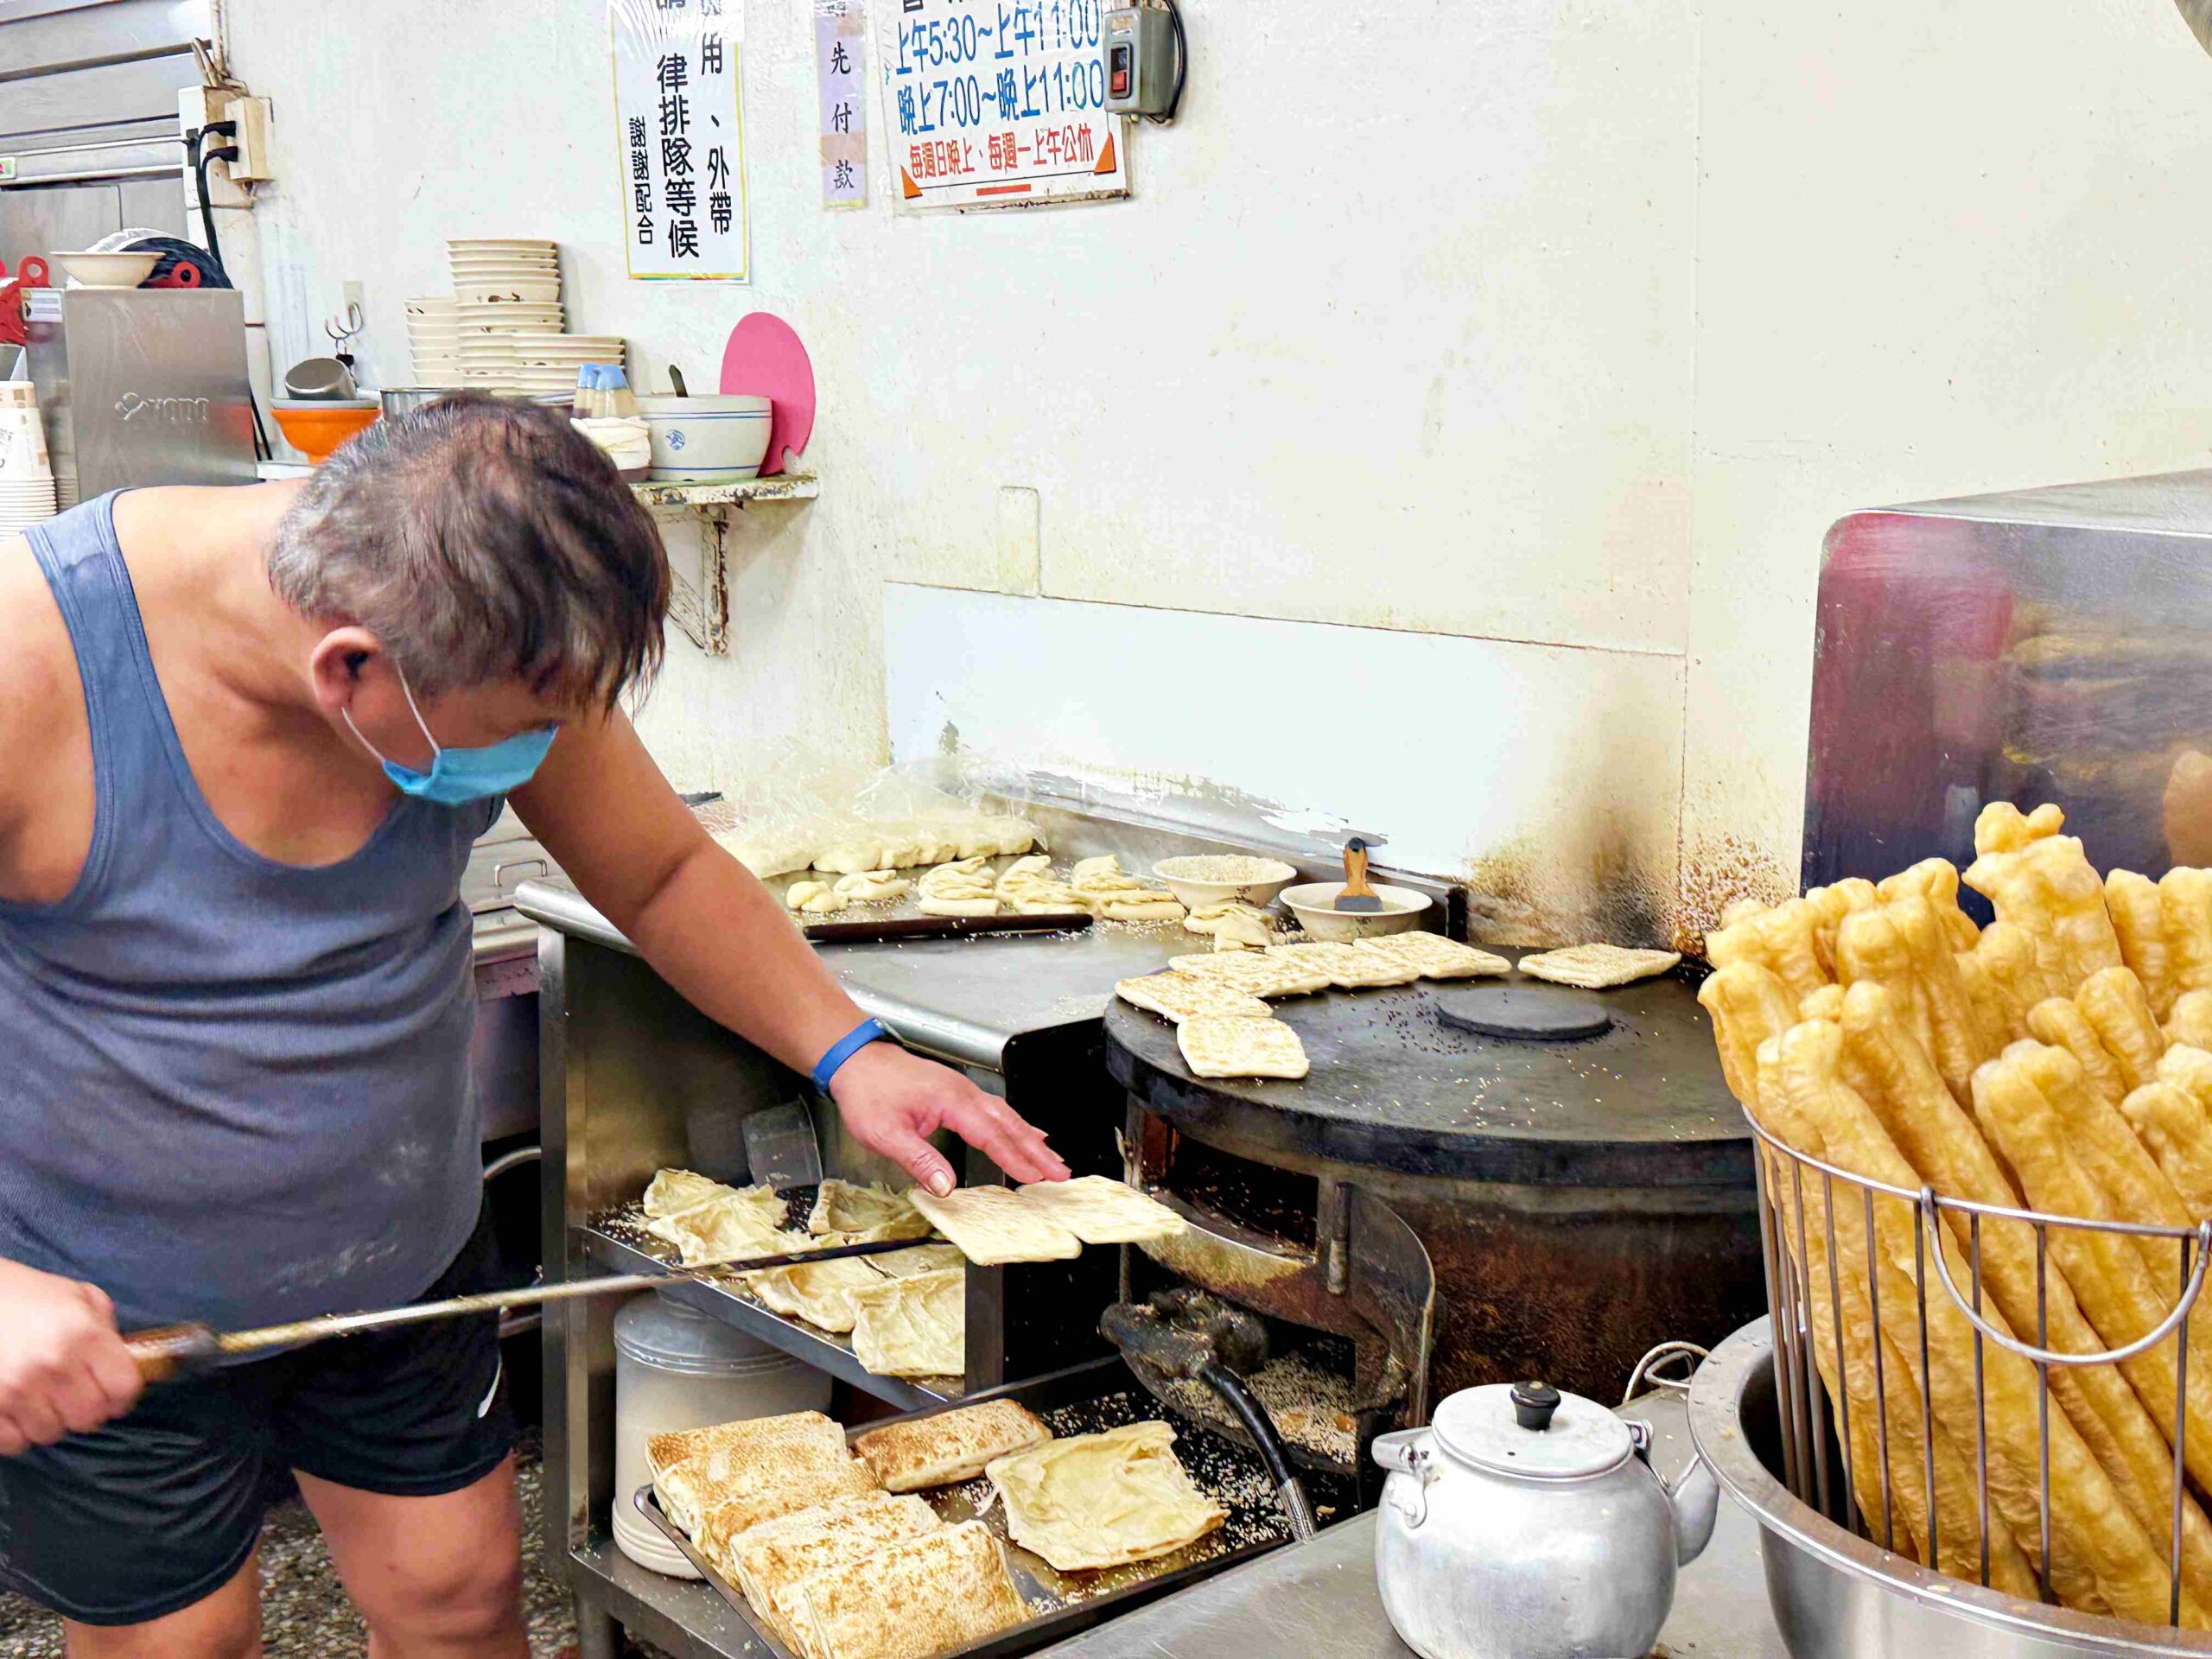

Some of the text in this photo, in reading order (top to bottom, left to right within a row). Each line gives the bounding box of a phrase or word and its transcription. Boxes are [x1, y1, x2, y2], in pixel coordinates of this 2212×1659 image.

[629, 116, 654, 245] 謝謝配合
[657, 0, 700, 258] 律排隊等候
